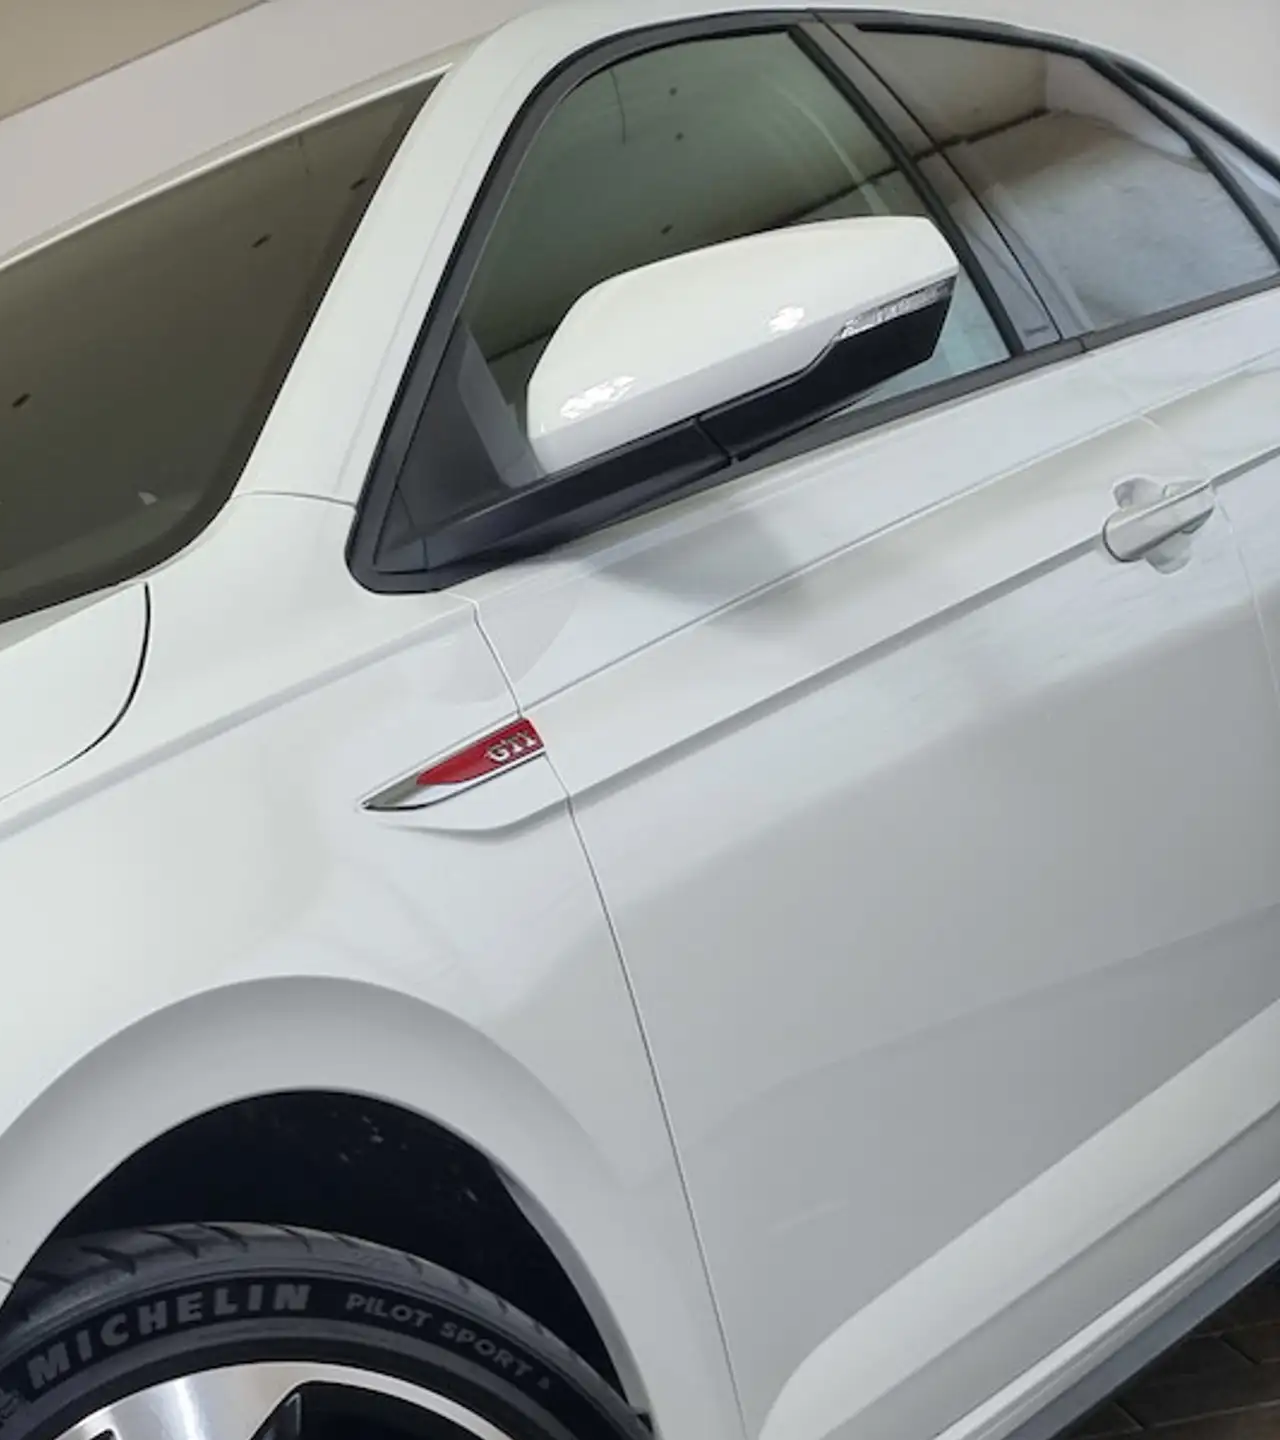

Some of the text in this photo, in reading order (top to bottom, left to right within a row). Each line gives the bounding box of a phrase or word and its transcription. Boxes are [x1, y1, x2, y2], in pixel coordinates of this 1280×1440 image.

[487, 729, 537, 763] GTI
[26, 1283, 534, 1389] MICHELIN PILOT SPORT
